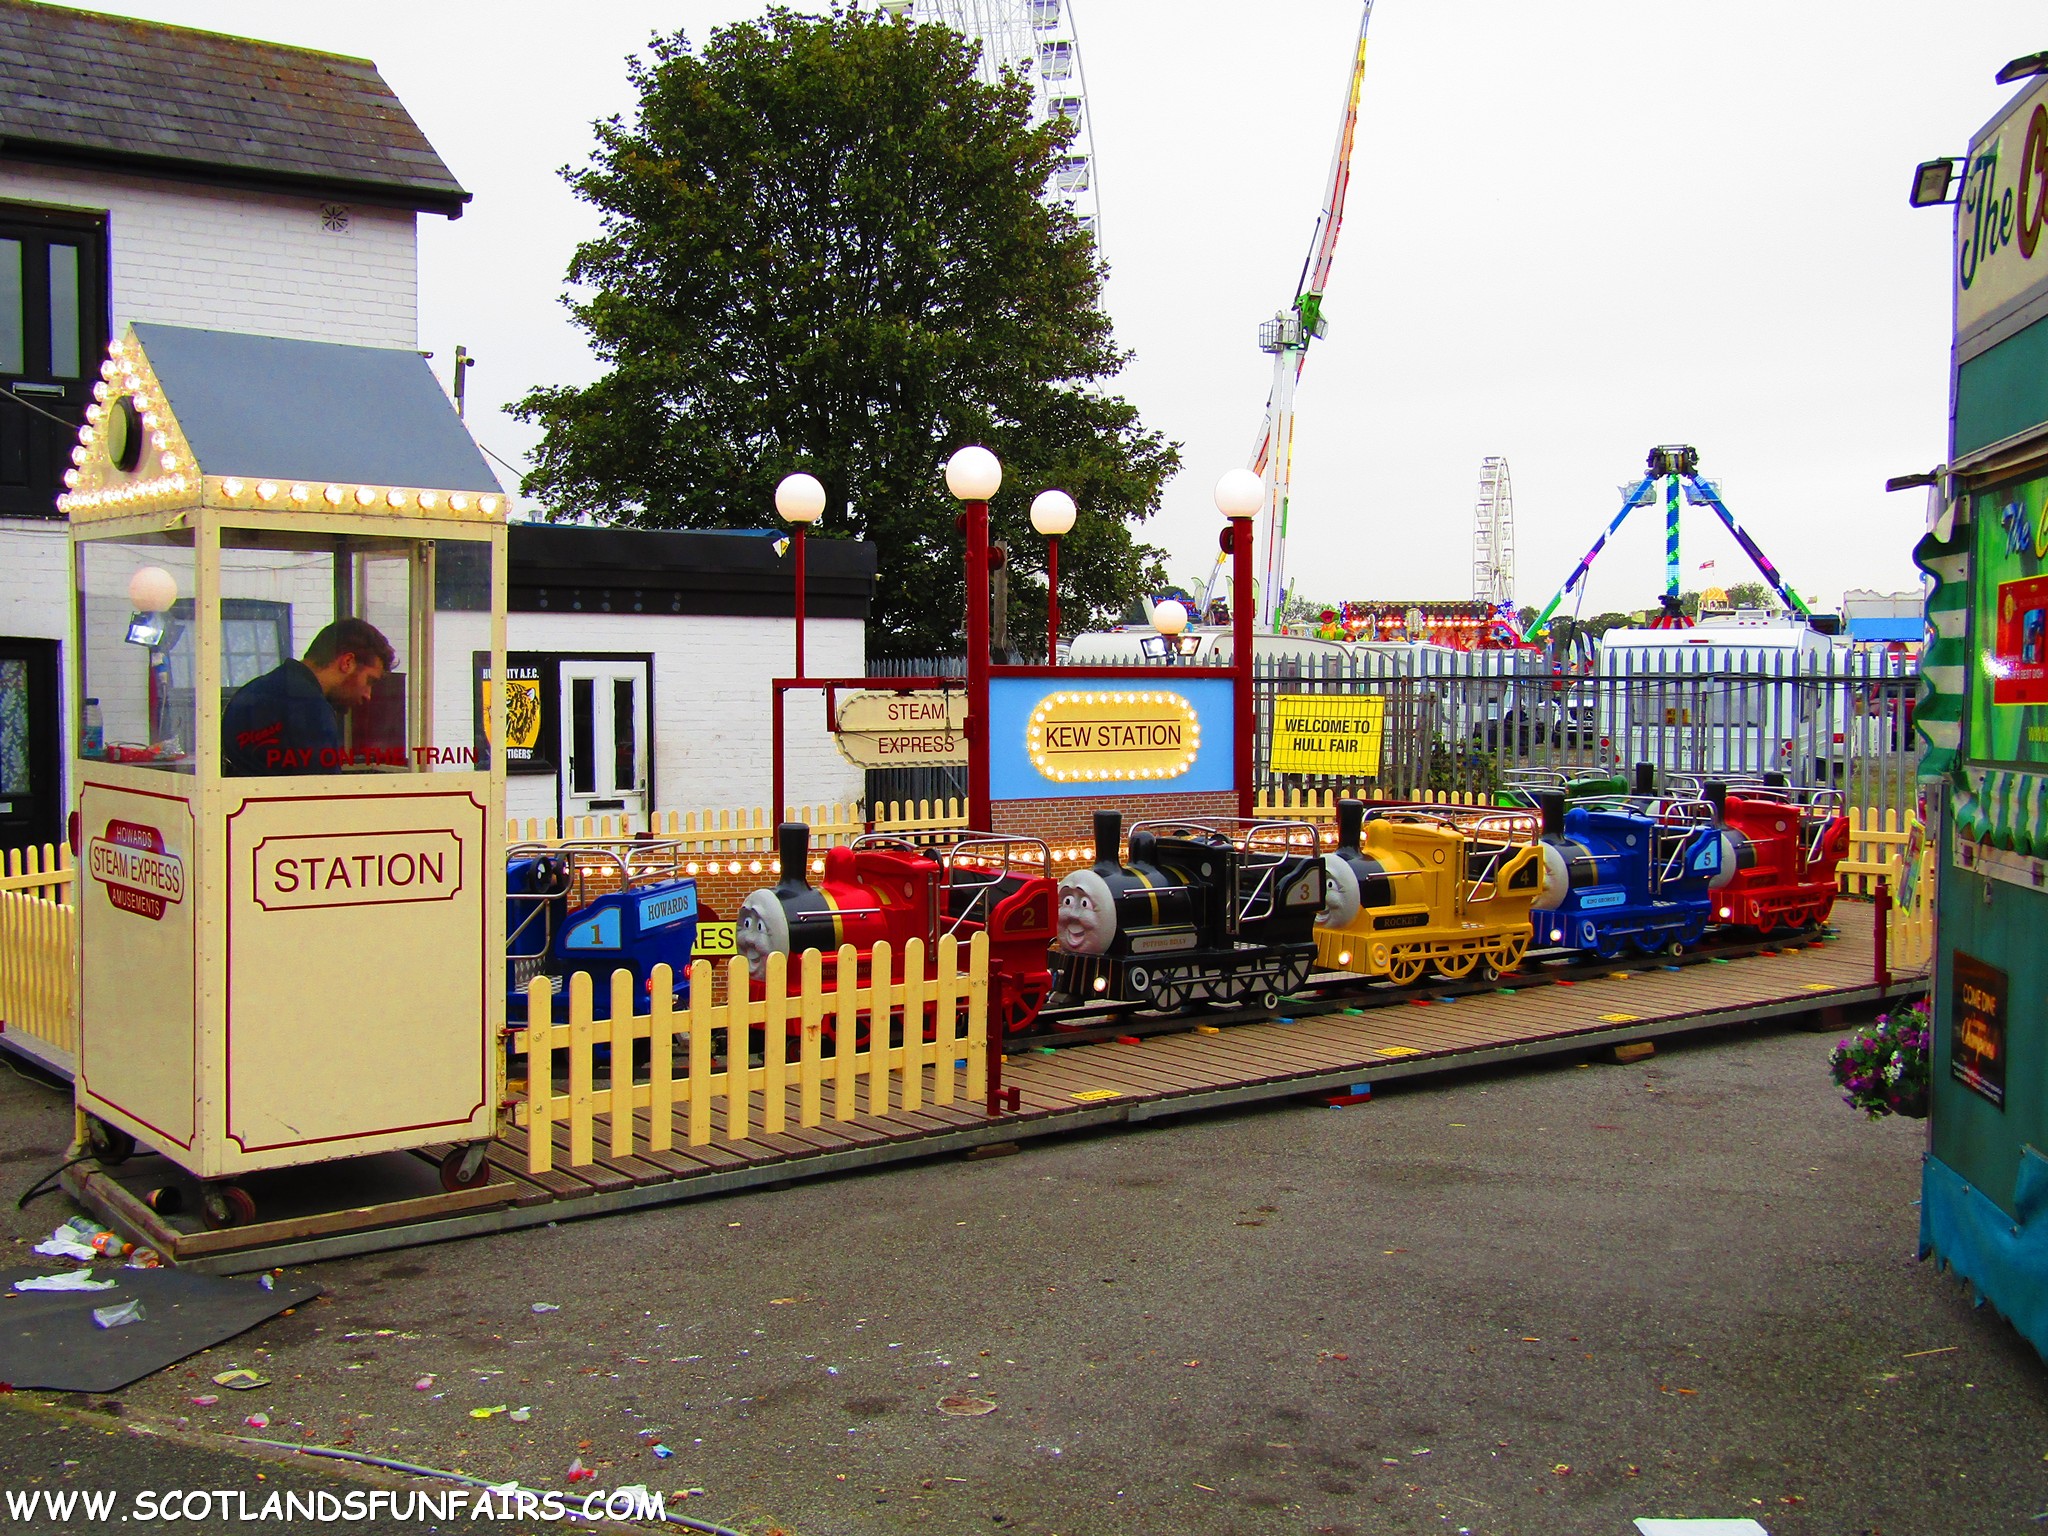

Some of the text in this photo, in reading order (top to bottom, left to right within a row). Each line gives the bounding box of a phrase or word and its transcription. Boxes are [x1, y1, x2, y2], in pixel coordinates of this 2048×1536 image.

[1961, 135, 2015, 290] The
[506, 669, 518, 679] ITY
[888, 703, 945, 720] STEAM
[1285, 718, 1370, 734] WELCOME TO
[878, 735, 955, 754] EXPRESS
[1046, 725, 1181, 748] KEW STATION
[1293, 737, 1359, 753] HULL FAIR
[266, 746, 479, 769] PAY ON THE TRAIN
[116, 826, 152, 848] HOWARDS
[1703, 852, 1711, 866] 5
[93, 846, 180, 894] STEAM EXPRESS
[274, 852, 443, 893] STATION
[1519, 870, 1530, 885] 4
[1300, 883, 1310, 901] 3
[112, 888, 160, 917] AMUSEMENTS
[648, 895, 689, 922] HOWARDS
[1022, 907, 1035, 926] 2
[1384, 915, 1420, 928] ROCKET
[591, 924, 604, 945] 1
